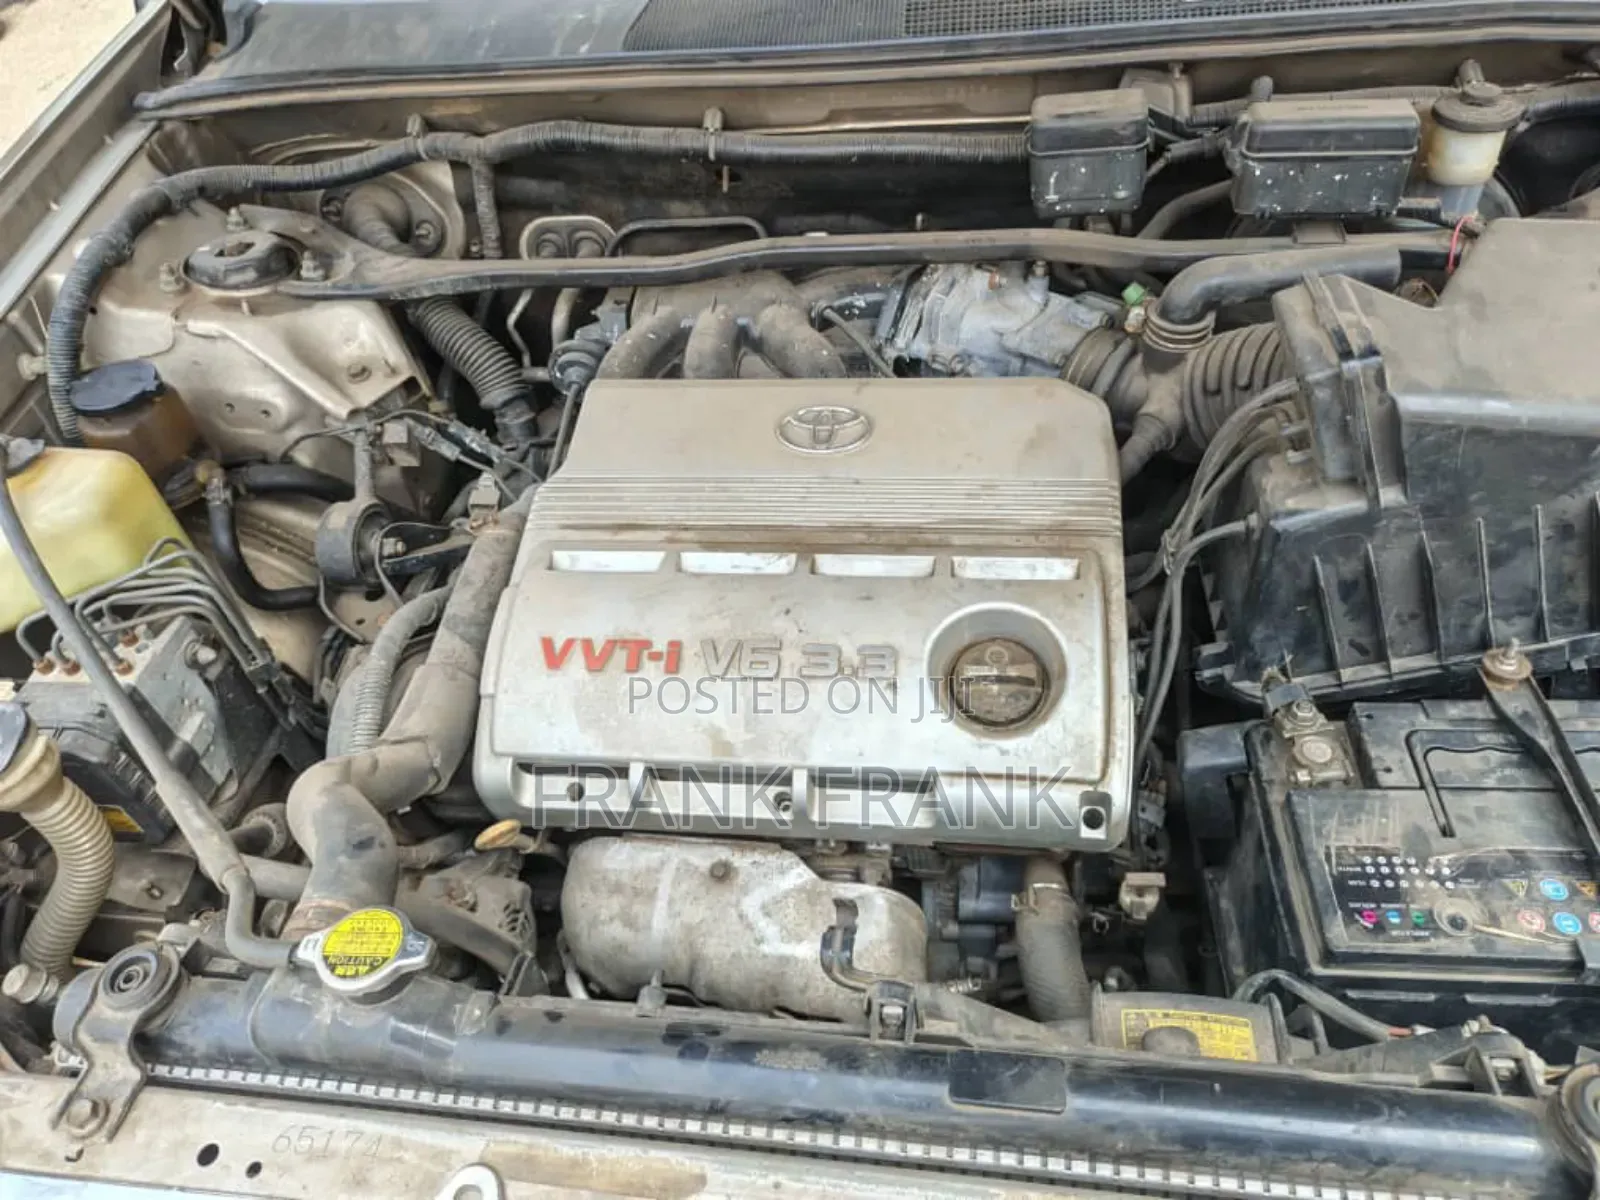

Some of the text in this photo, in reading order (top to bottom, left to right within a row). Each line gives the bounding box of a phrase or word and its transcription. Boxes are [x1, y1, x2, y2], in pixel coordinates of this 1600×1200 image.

[540, 636, 899, 680] VVT-i V6 3.3
[327, 955, 383, 965] CAUTION
